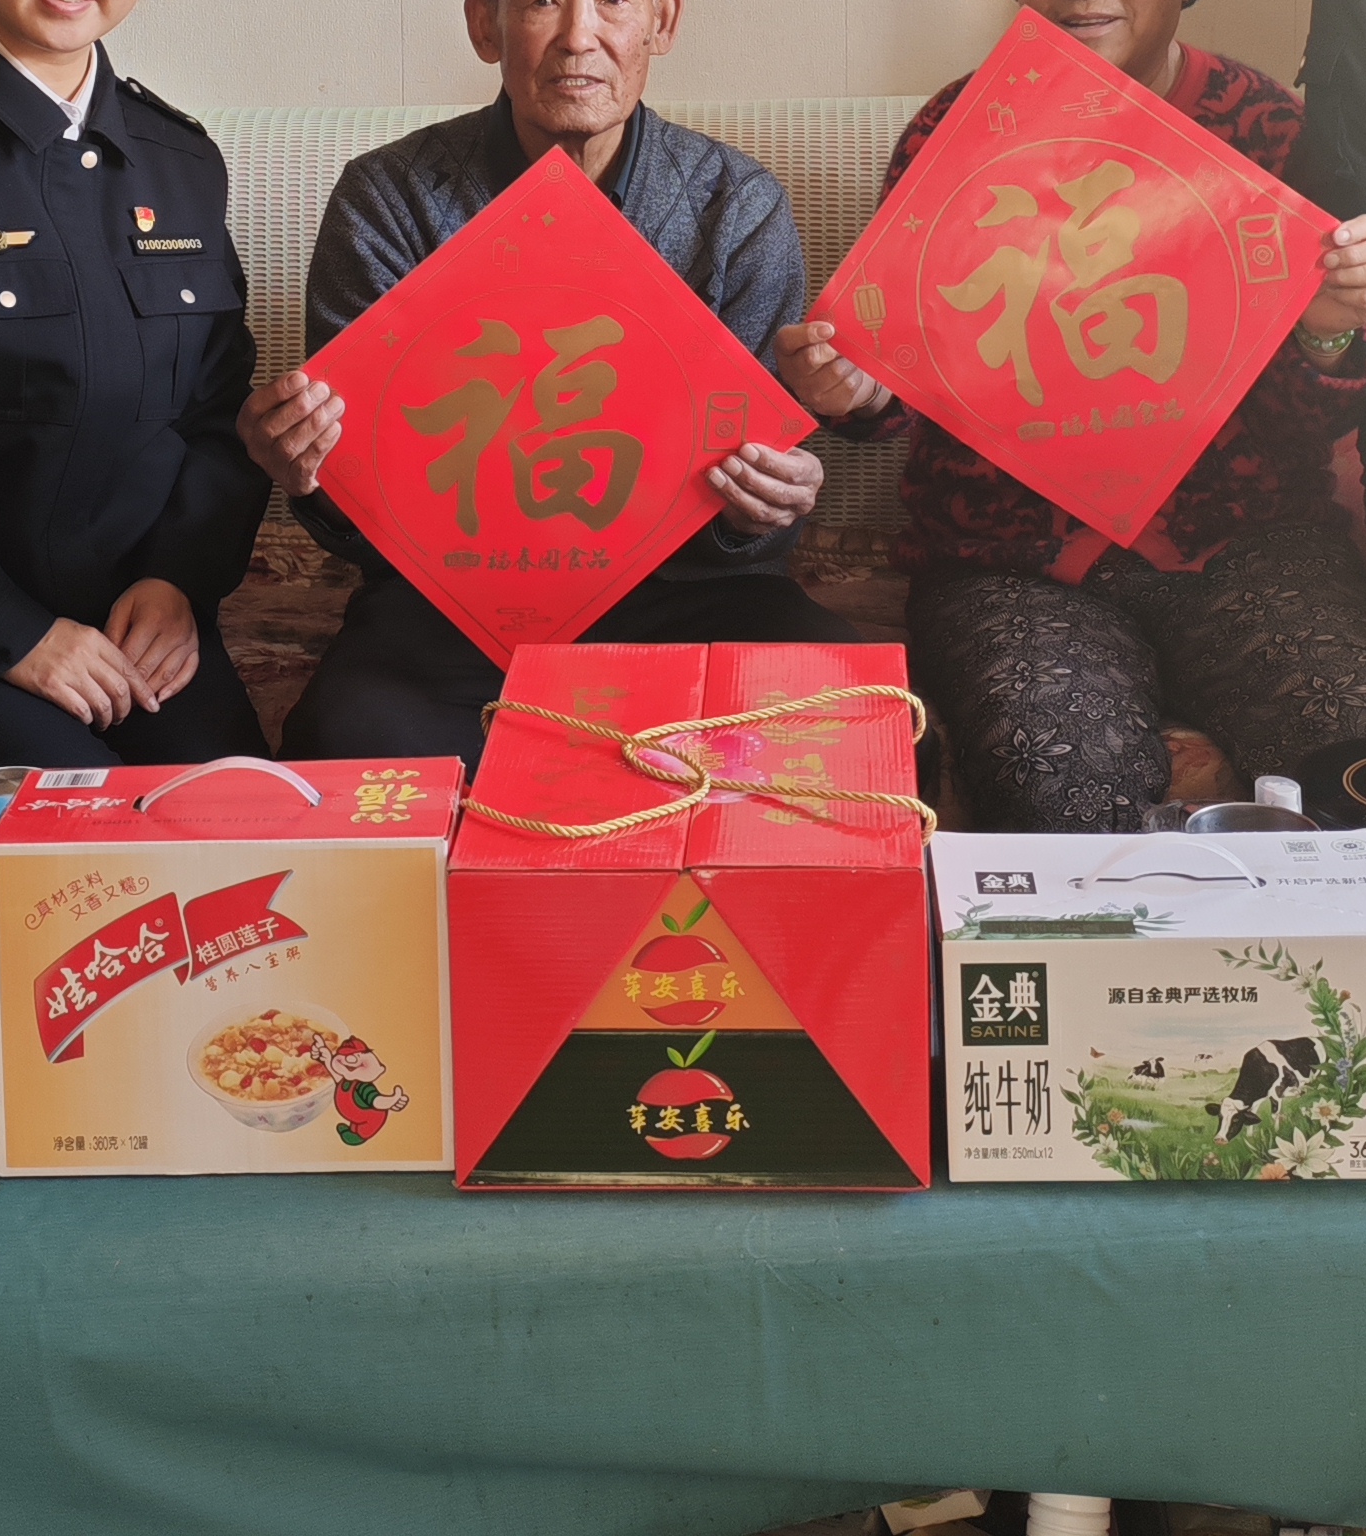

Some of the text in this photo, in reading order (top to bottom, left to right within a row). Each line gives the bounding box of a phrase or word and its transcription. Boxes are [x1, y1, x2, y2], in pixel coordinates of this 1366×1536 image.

[136, 238, 203, 250] 01002008003
[936, 158, 1188, 407] 福
[399, 314, 645, 537] 福
[34, 870, 104, 918] 真材实料
[69, 875, 138, 922] 又香又糯
[981, 873, 1031, 890] 金典
[195, 916, 280, 966] 桂圆莲子
[45, 922, 170, 1020] 娃哈哈
[204, 945, 302, 992] 营养八宝粥
[968, 971, 1041, 1023] 金典
[1108, 985, 1259, 1005] 源自金典严选牧场
[970, 1024, 1042, 1038] SATINE
[964, 1059, 1052, 1136] 纯牛奶
